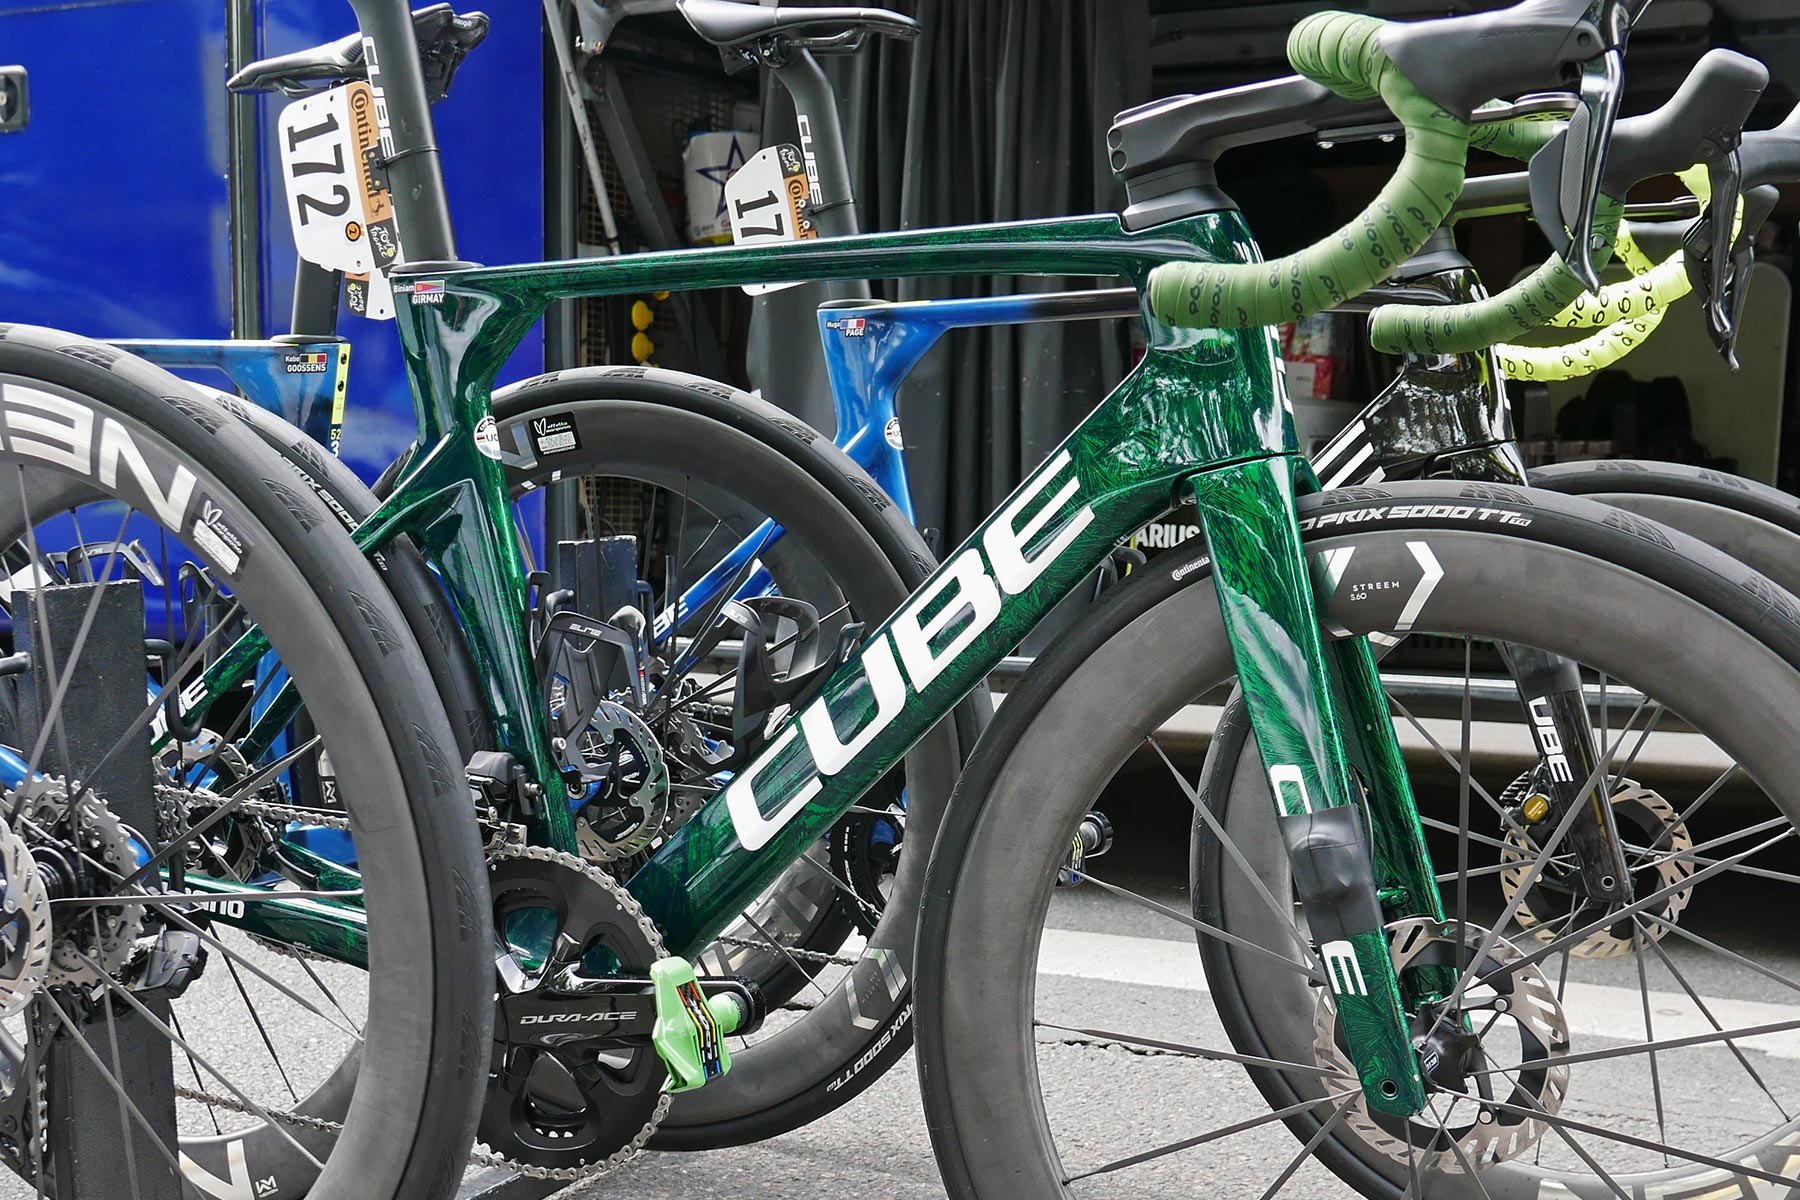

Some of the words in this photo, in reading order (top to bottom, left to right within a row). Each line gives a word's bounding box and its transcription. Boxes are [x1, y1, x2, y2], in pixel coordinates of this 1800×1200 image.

[362, 36, 396, 160] CUBE
[287, 112, 351, 227] 172
[797, 114, 823, 206] CUBE
[735, 190, 785, 239] 17
[412, 294, 445, 305] GIRMAY
[845, 328, 864, 337] PAGE
[287, 363, 327, 373] GOOSSENS
[330, 428, 341, 441] 52
[0, 383, 198, 534] NE
[1316, 505, 1390, 530] PRIX
[1386, 504, 1474, 520] 5000
[1171, 555, 1211, 582] Continenta
[1352, 581, 1401, 592] STREEM
[726, 448, 1097, 852] CUBE
[1528, 696, 1574, 783] UBE
[520, 1010, 638, 1025] DURA-ACE
[853, 1030, 892, 1075] 5000
